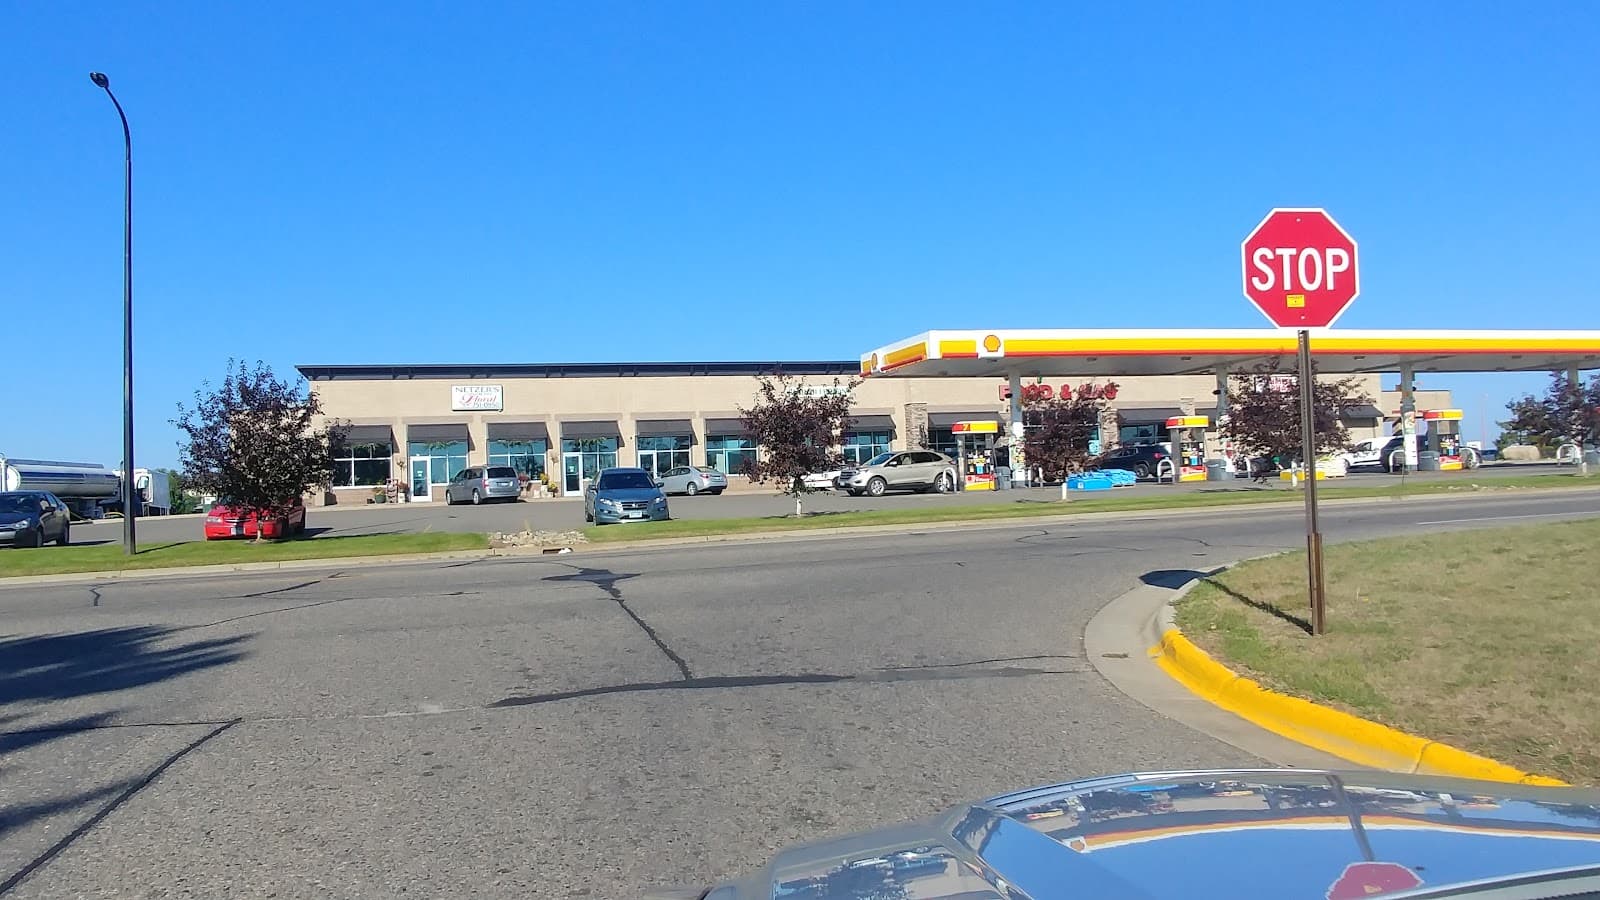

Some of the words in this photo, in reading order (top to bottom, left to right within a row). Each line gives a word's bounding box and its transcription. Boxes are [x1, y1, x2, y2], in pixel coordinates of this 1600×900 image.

[1251, 247, 1350, 291] STOP
[461, 395, 497, 404] Floral
[1060, 384, 1072, 400] &
